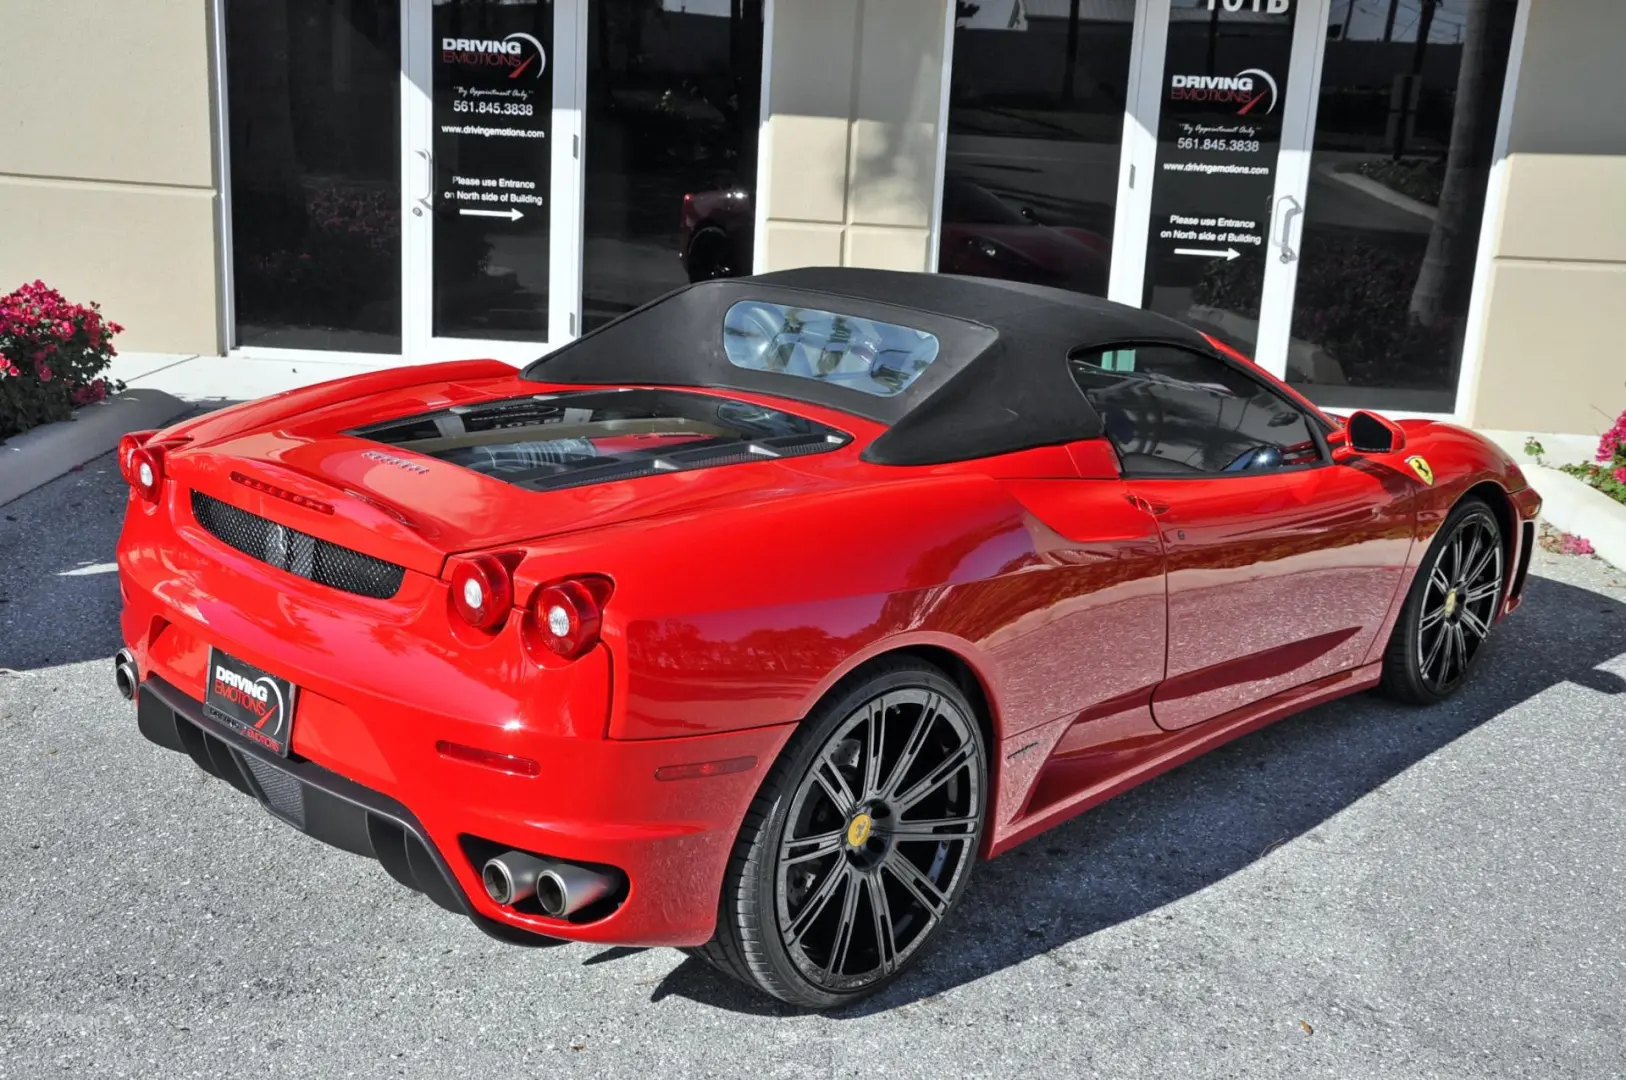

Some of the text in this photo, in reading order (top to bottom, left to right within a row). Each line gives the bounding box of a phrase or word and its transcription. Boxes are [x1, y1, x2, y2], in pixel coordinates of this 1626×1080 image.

[442, 38, 521, 54] DRIVING
[443, 50, 521, 67] EMOTIONS
[1171, 75, 1253, 91] DRIVING
[1170, 88, 1252, 103] EMOTIONS
[453, 100, 534, 116] 561.845.3838
[441, 125, 545, 138] www.drivingemotions.com
[1177, 137, 1260, 153] 561.845.3838
[1163, 162, 1270, 175] www.drivingemotions.com
[452, 175, 536, 190] Please use Entrance
[444, 190, 544, 206] on North side of Building
[1169, 214, 1256, 229] Please use Entrance
[1160, 229, 1262, 246] on North side of Building
[216, 666, 268, 702] DRIVING
[215, 681, 266, 716] EMOTIONS
